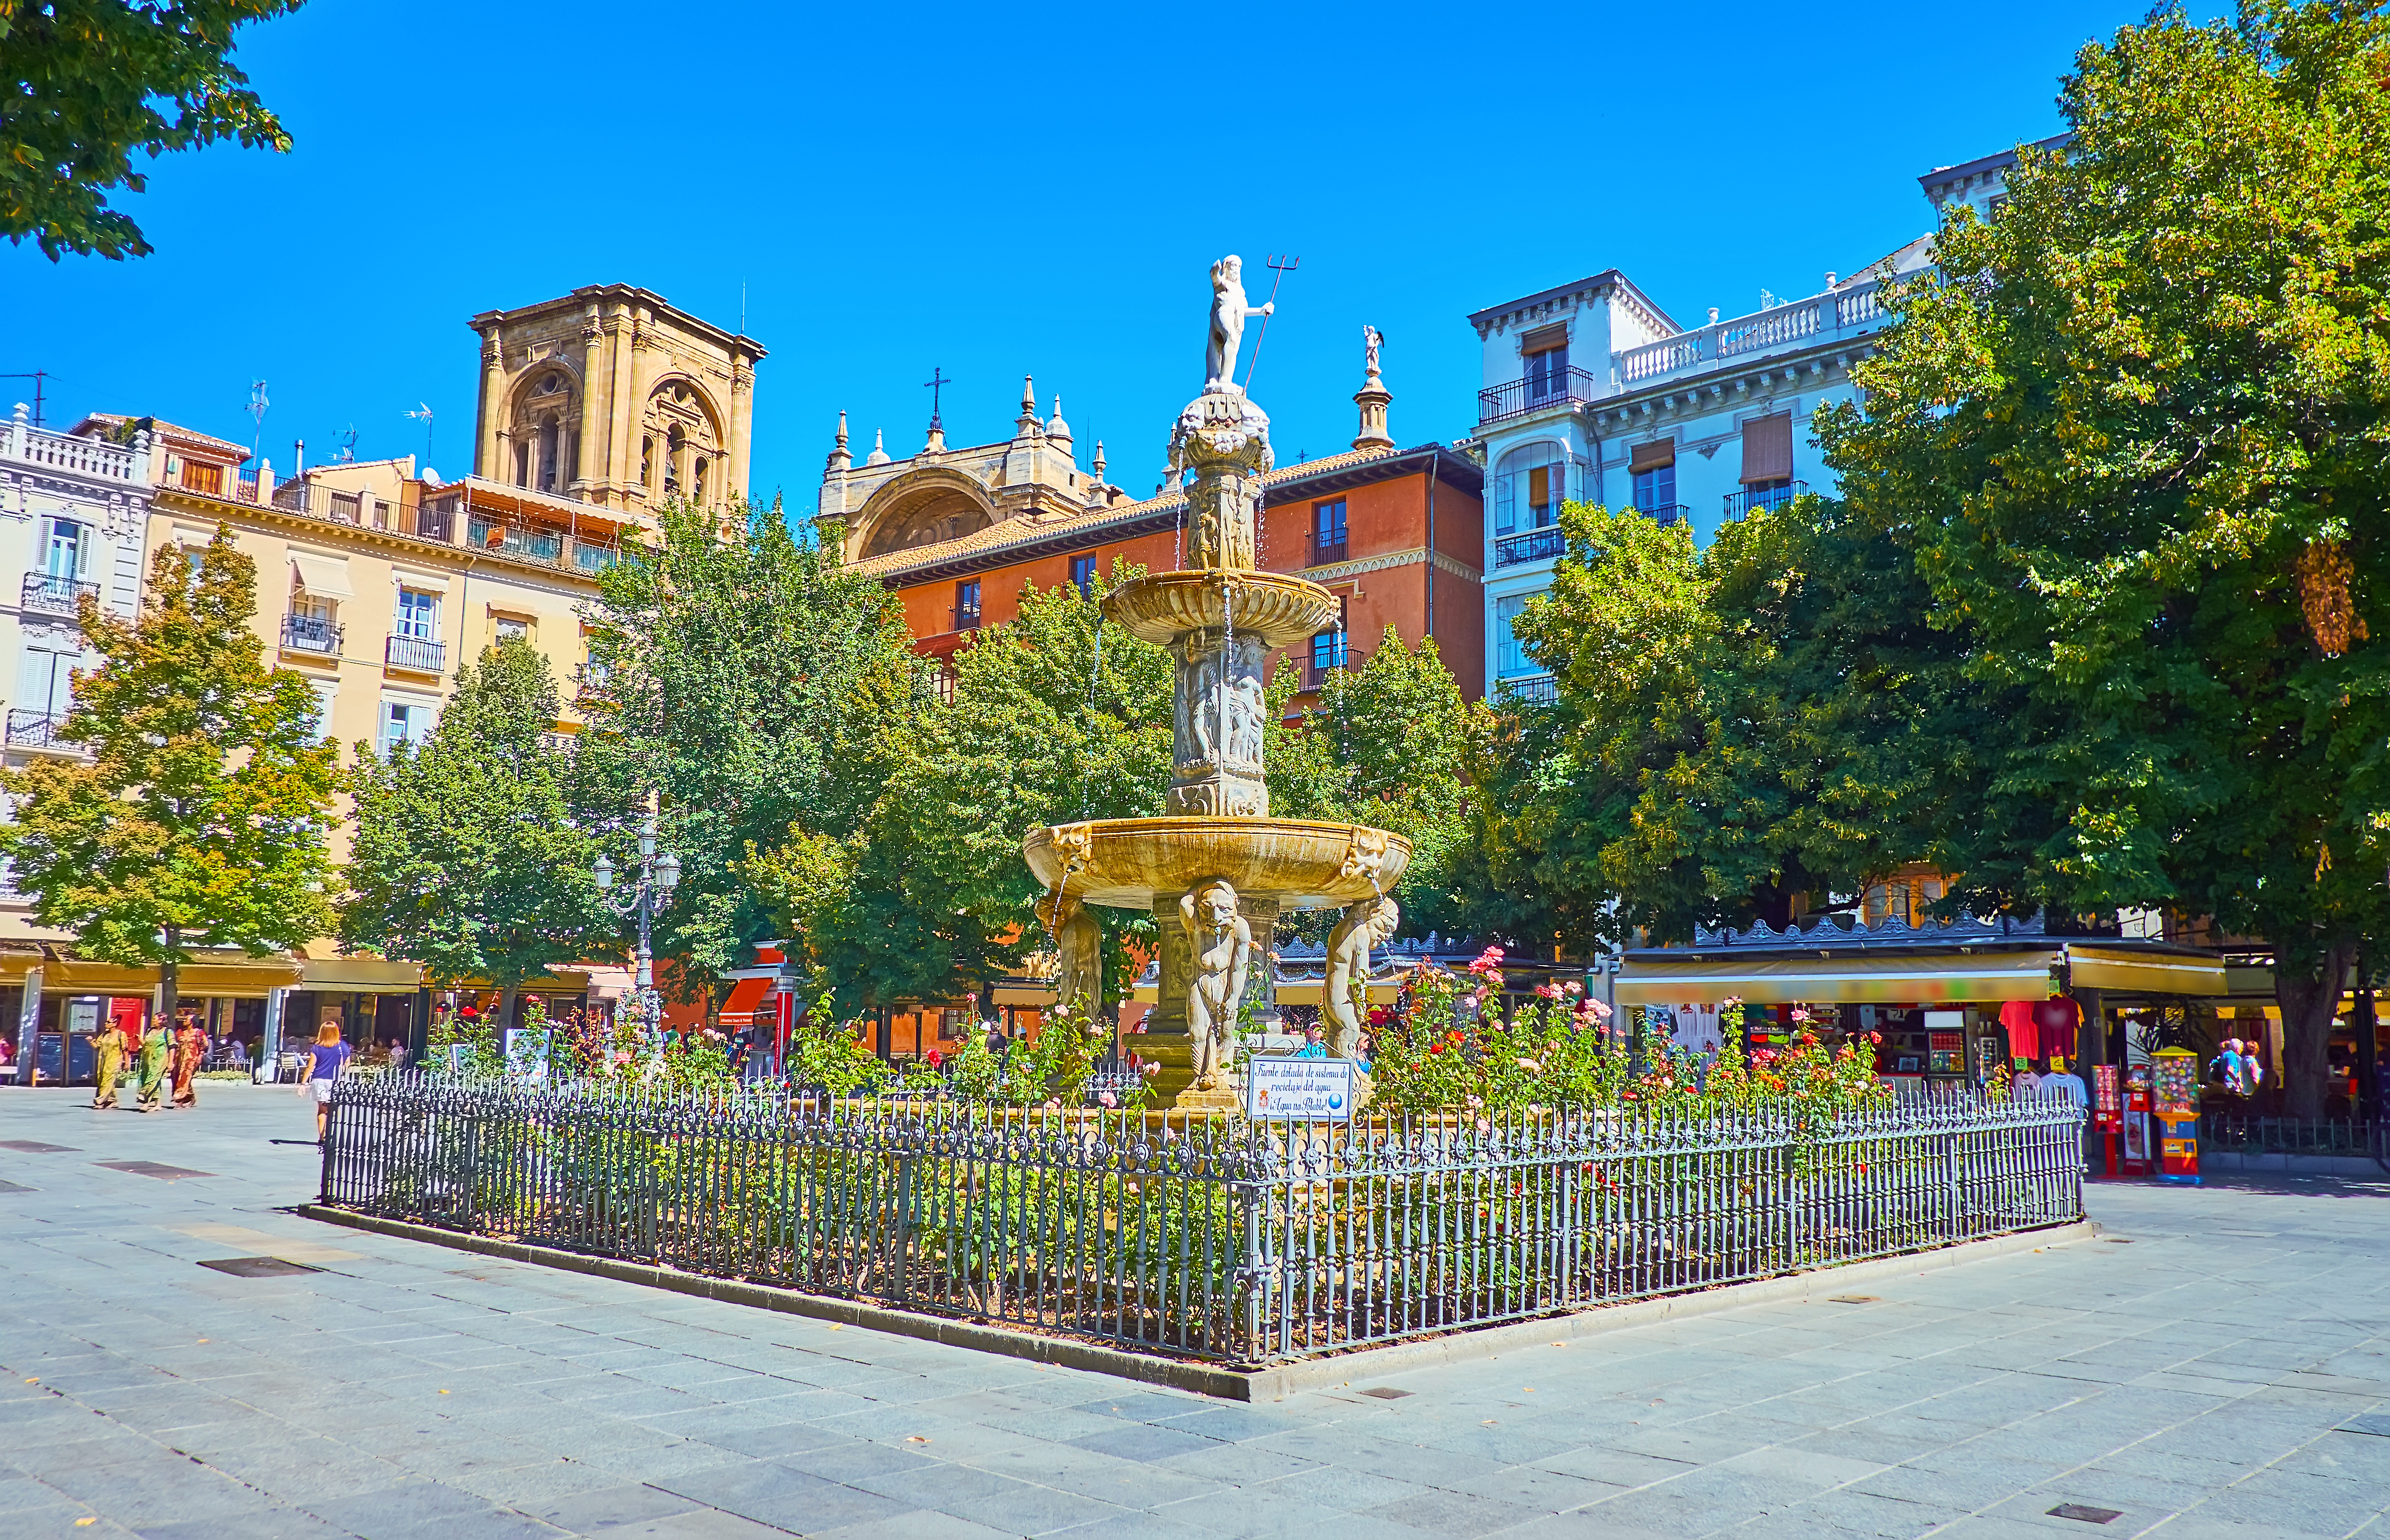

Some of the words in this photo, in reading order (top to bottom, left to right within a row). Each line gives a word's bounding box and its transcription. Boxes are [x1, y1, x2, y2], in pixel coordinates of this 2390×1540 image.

[1255, 1063, 1278, 1077] Fuente
[1281, 1063, 1303, 1077] dotada
[1305, 1064, 1314, 1078] de
[1315, 1065, 1339, 1078] sistema
[1340, 1065, 1348, 1079] de
[1271, 1079, 1301, 1094] reciclaje
[1303, 1079, 1313, 1091] del
[1315, 1084, 1331, 1095] agua
[1270, 1097, 1292, 1114] ¡Agua
[1293, 1103, 1301, 1111] no
[1301, 1097, 1327, 1111] Potable!
